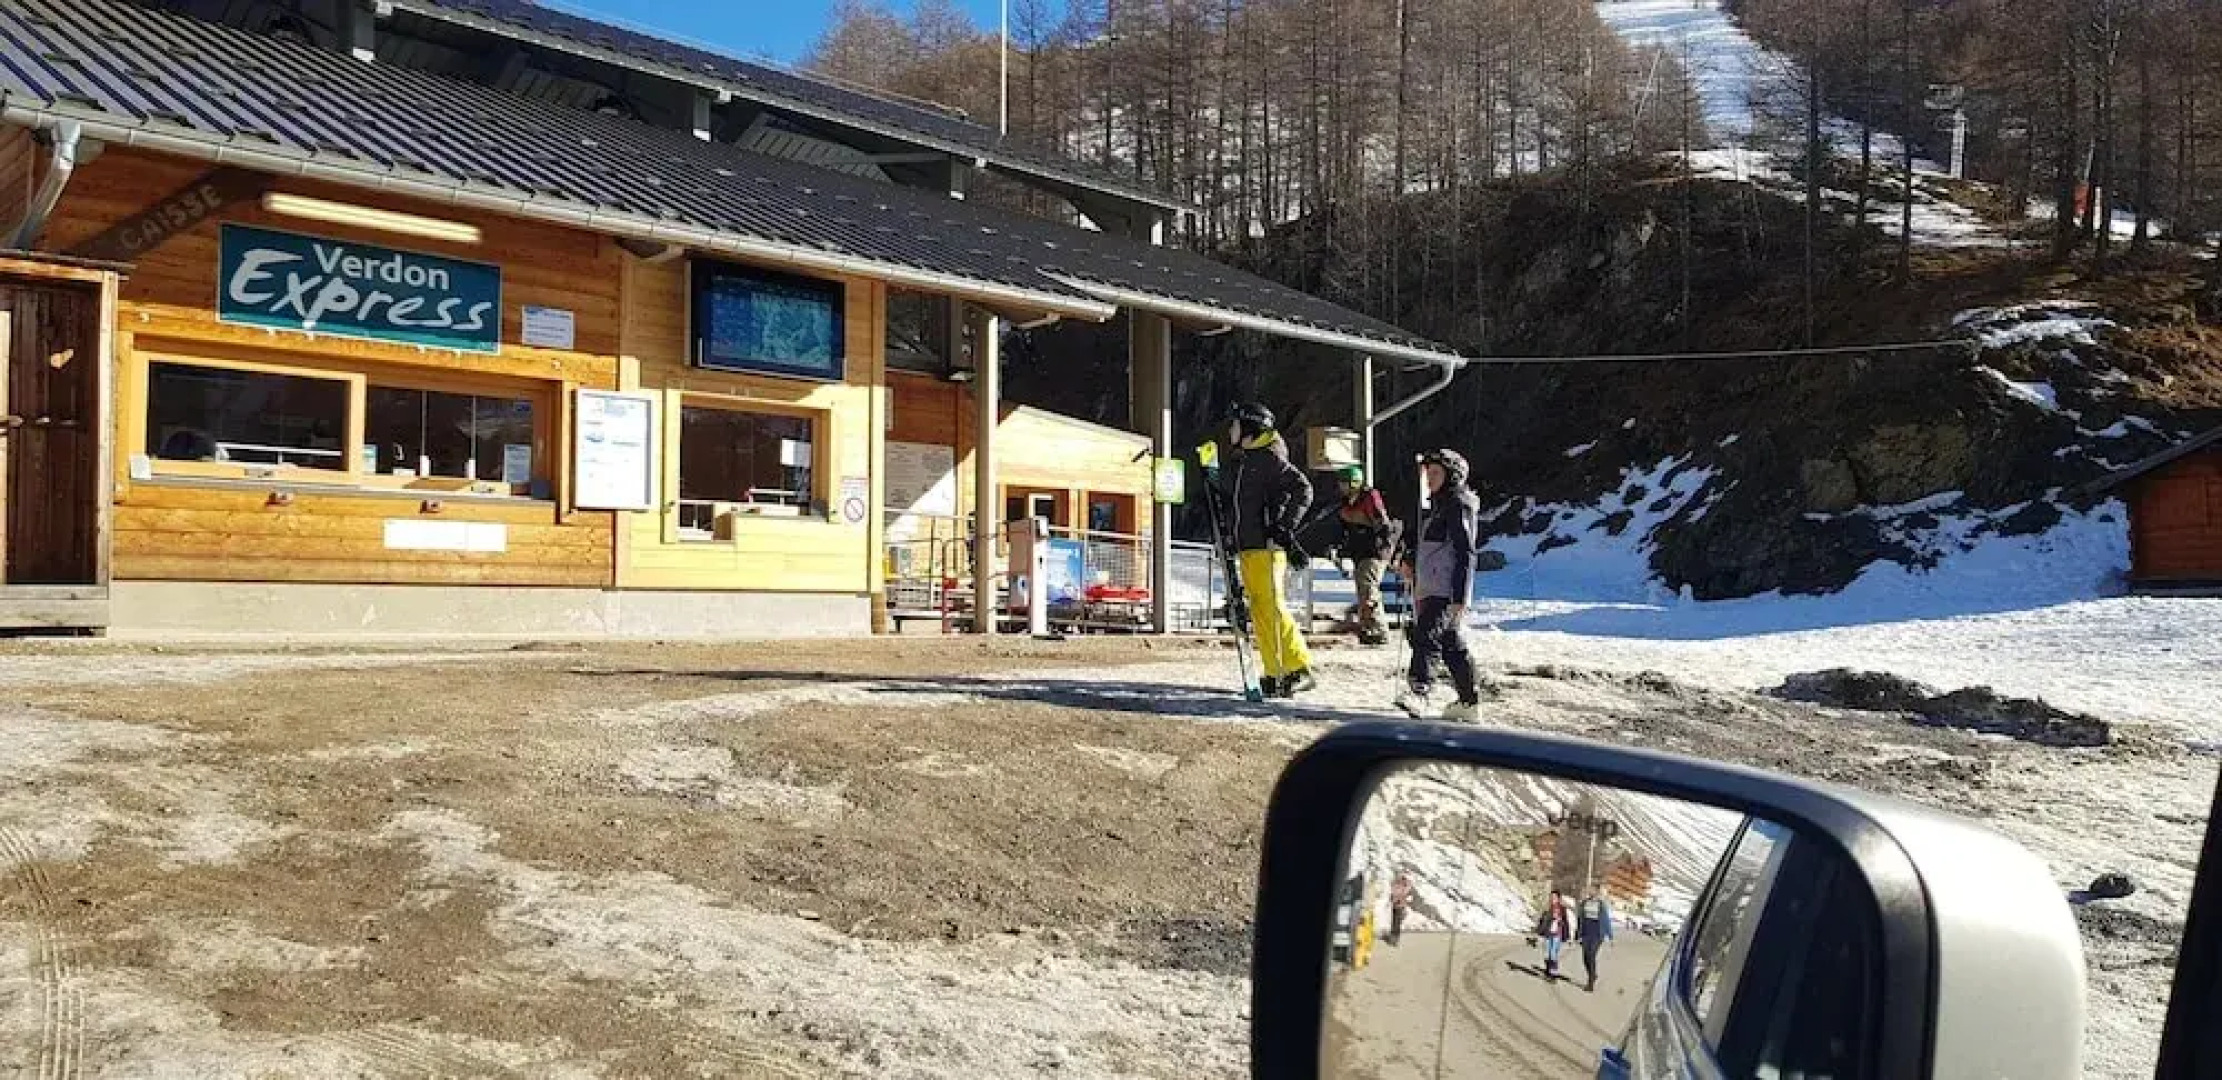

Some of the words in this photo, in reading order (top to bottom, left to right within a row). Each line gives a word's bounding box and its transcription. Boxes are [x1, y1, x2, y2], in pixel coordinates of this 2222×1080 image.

[120, 184, 222, 249] CAISSE
[228, 248, 492, 330] Express
[312, 243, 450, 290] Verdon
[1547, 802, 1618, 842] Jeep
